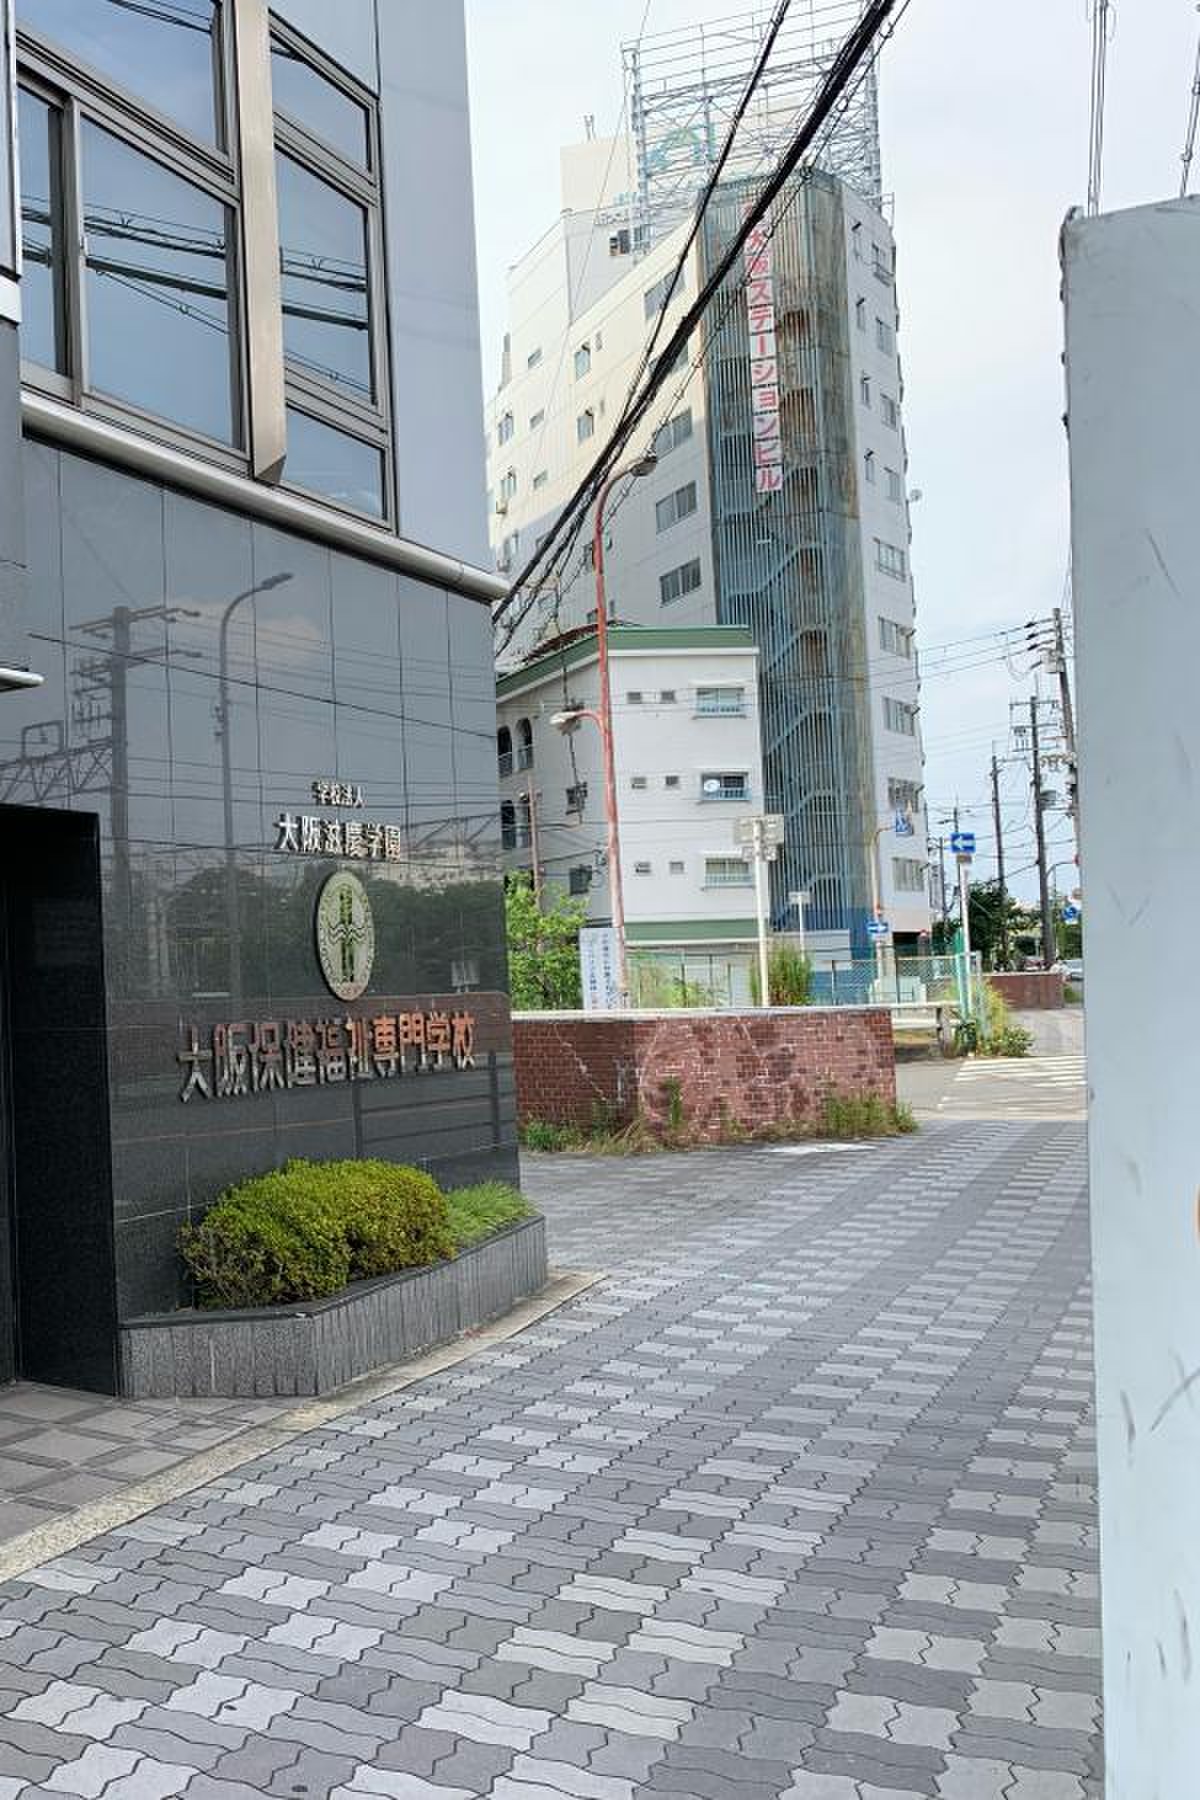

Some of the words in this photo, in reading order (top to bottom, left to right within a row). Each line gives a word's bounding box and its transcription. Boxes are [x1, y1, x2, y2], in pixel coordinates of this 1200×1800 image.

[313, 780, 367, 807] 学校法人
[177, 1011, 476, 1103] 大阪保健福祉専門学校
